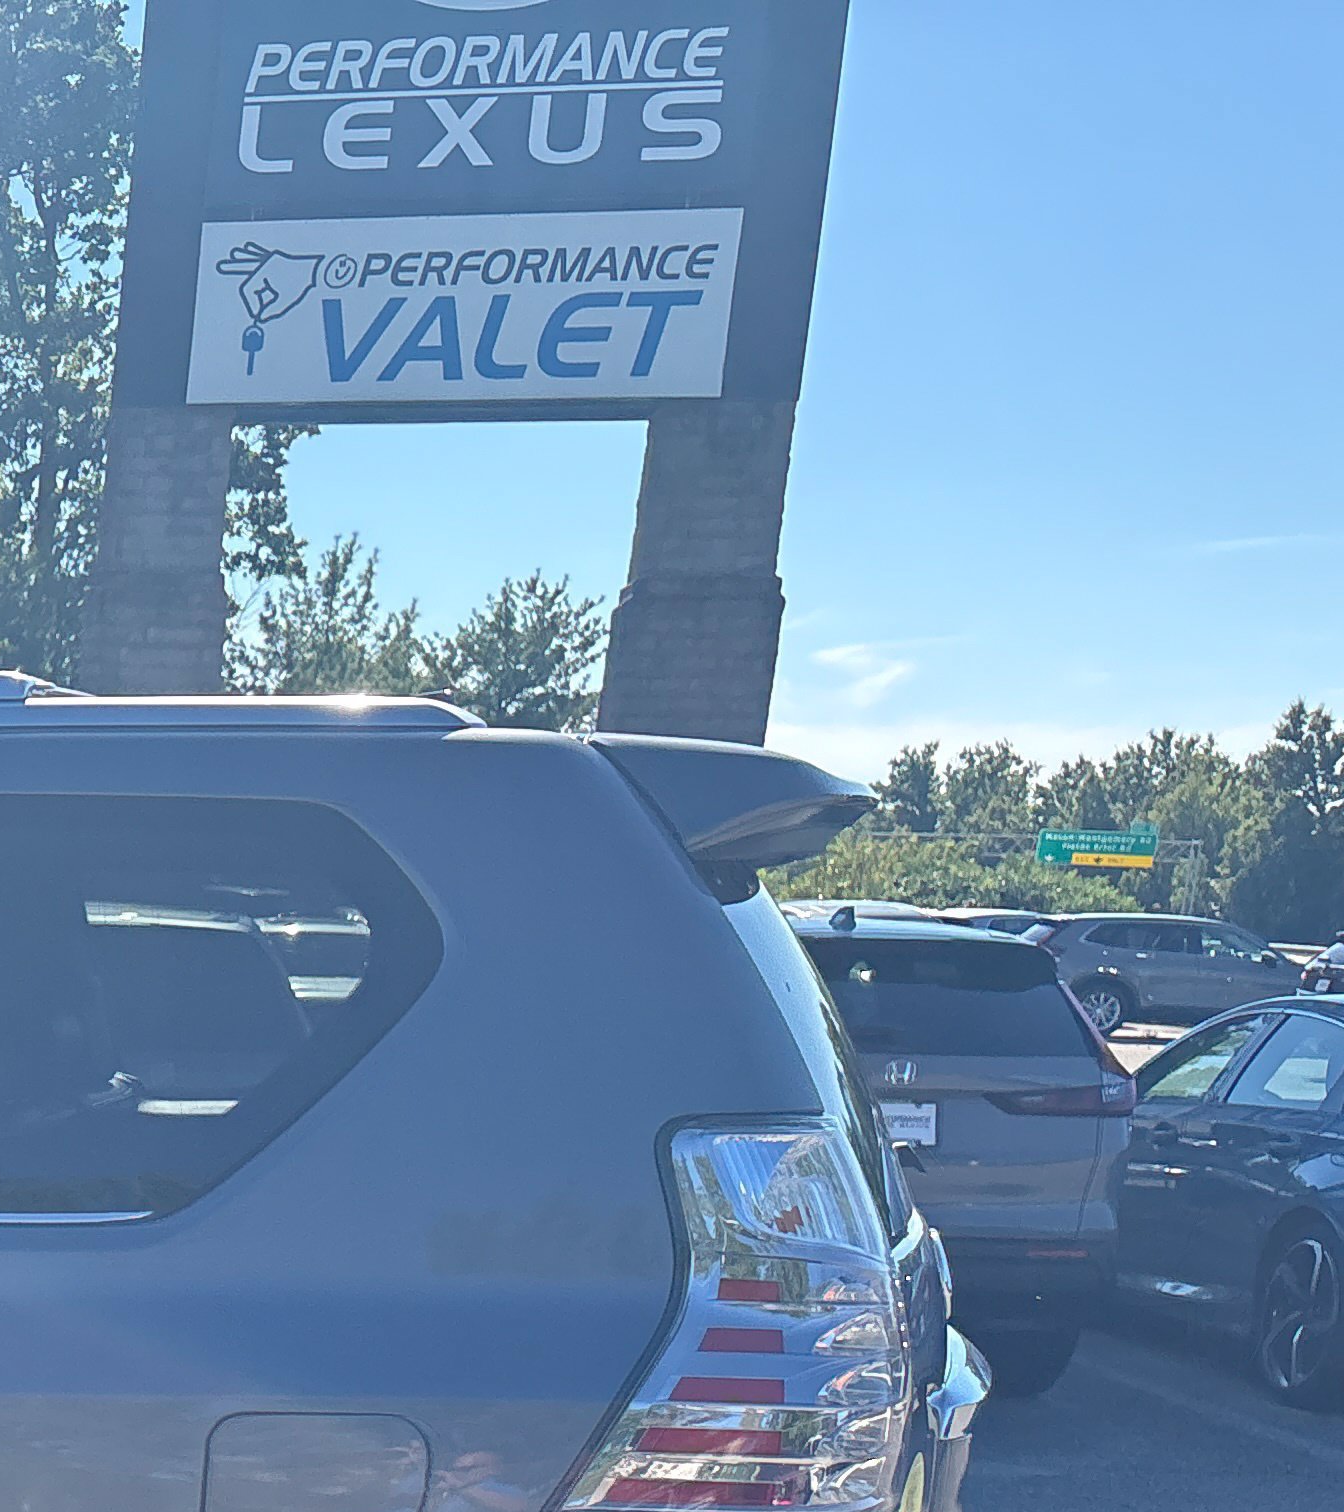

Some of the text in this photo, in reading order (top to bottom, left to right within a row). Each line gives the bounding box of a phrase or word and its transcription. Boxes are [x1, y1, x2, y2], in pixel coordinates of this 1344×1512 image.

[245, 26, 730, 94] PERFORMANCE
[238, 88, 723, 173] LEXUS
[358, 243, 720, 288] PERFORMANCE
[321, 290, 704, 383] VALET
